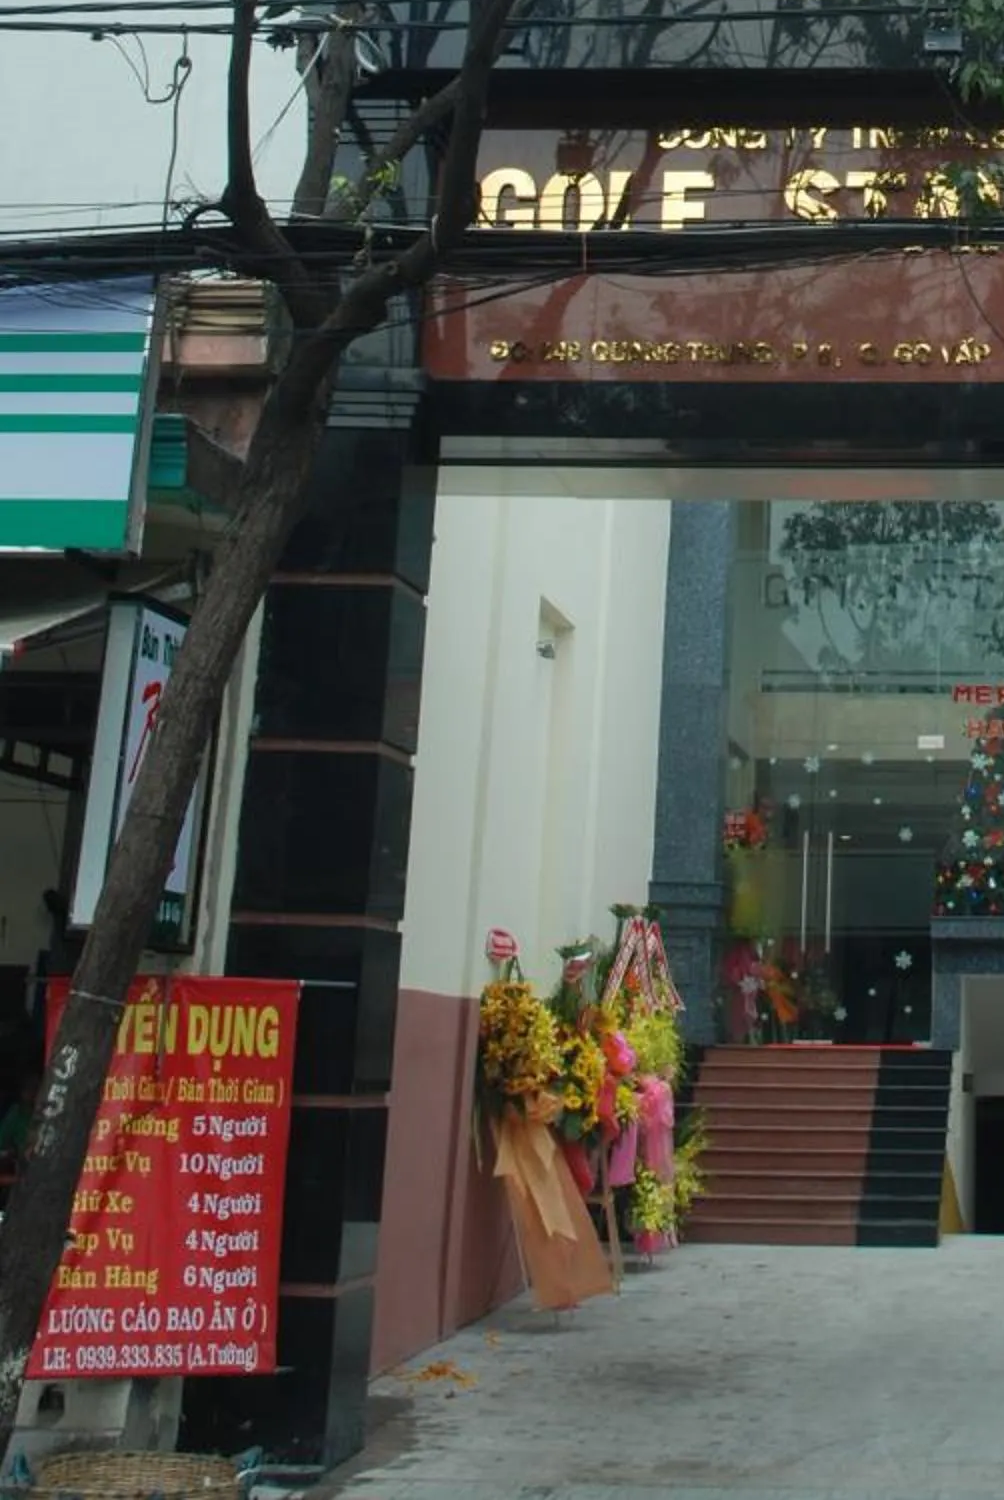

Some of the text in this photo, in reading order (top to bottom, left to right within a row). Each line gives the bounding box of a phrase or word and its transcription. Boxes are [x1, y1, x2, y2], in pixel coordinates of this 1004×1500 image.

[186, 1004, 280, 1073] DỤNG
[177, 1076, 205, 1103] Bán
[207, 1075, 240, 1103] Thời
[243, 1077, 275, 1104] Gian
[192, 1115, 206, 1136] 5
[208, 1115, 268, 1143] Người
[124, 1150, 152, 1178] Vụ
[179, 1153, 205, 1174] 10
[207, 1153, 264, 1181] Người
[105, 1190, 134, 1214] Xe
[187, 1192, 200, 1214] 4
[202, 1192, 261, 1220] Người
[105, 1227, 135, 1255] Vụ
[185, 1229, 199, 1251] 4
[200, 1229, 259, 1257] Người
[103, 1264, 160, 1295] Hàng
[182, 1264, 197, 1286] 6
[198, 1266, 257, 1294] Người
[48, 1303, 115, 1334] LƯƠNG
[166, 1306, 204, 1333] BAO
[208, 1298, 237, 1332] ĂN
